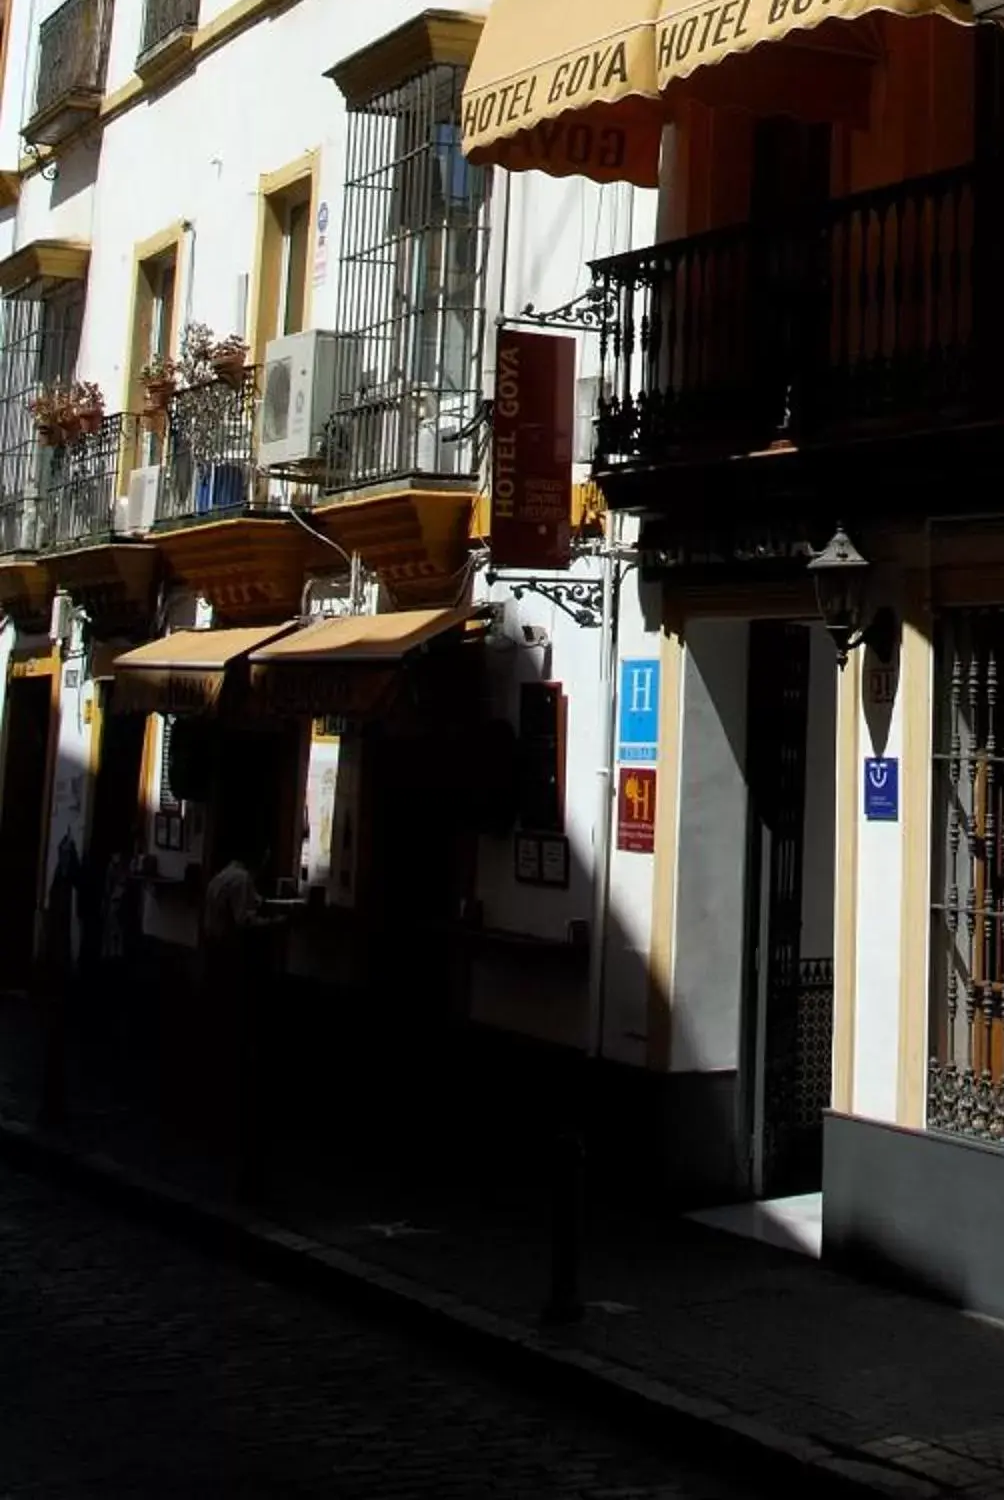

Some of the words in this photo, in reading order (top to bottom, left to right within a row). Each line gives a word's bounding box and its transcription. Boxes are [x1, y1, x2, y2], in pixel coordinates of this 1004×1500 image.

[463, 75, 537, 136] HOTEL
[548, 40, 627, 104] GOYA
[498, 344, 520, 418] GOYA
[495, 431, 517, 517] HOTEL
[629, 668, 653, 712] H
